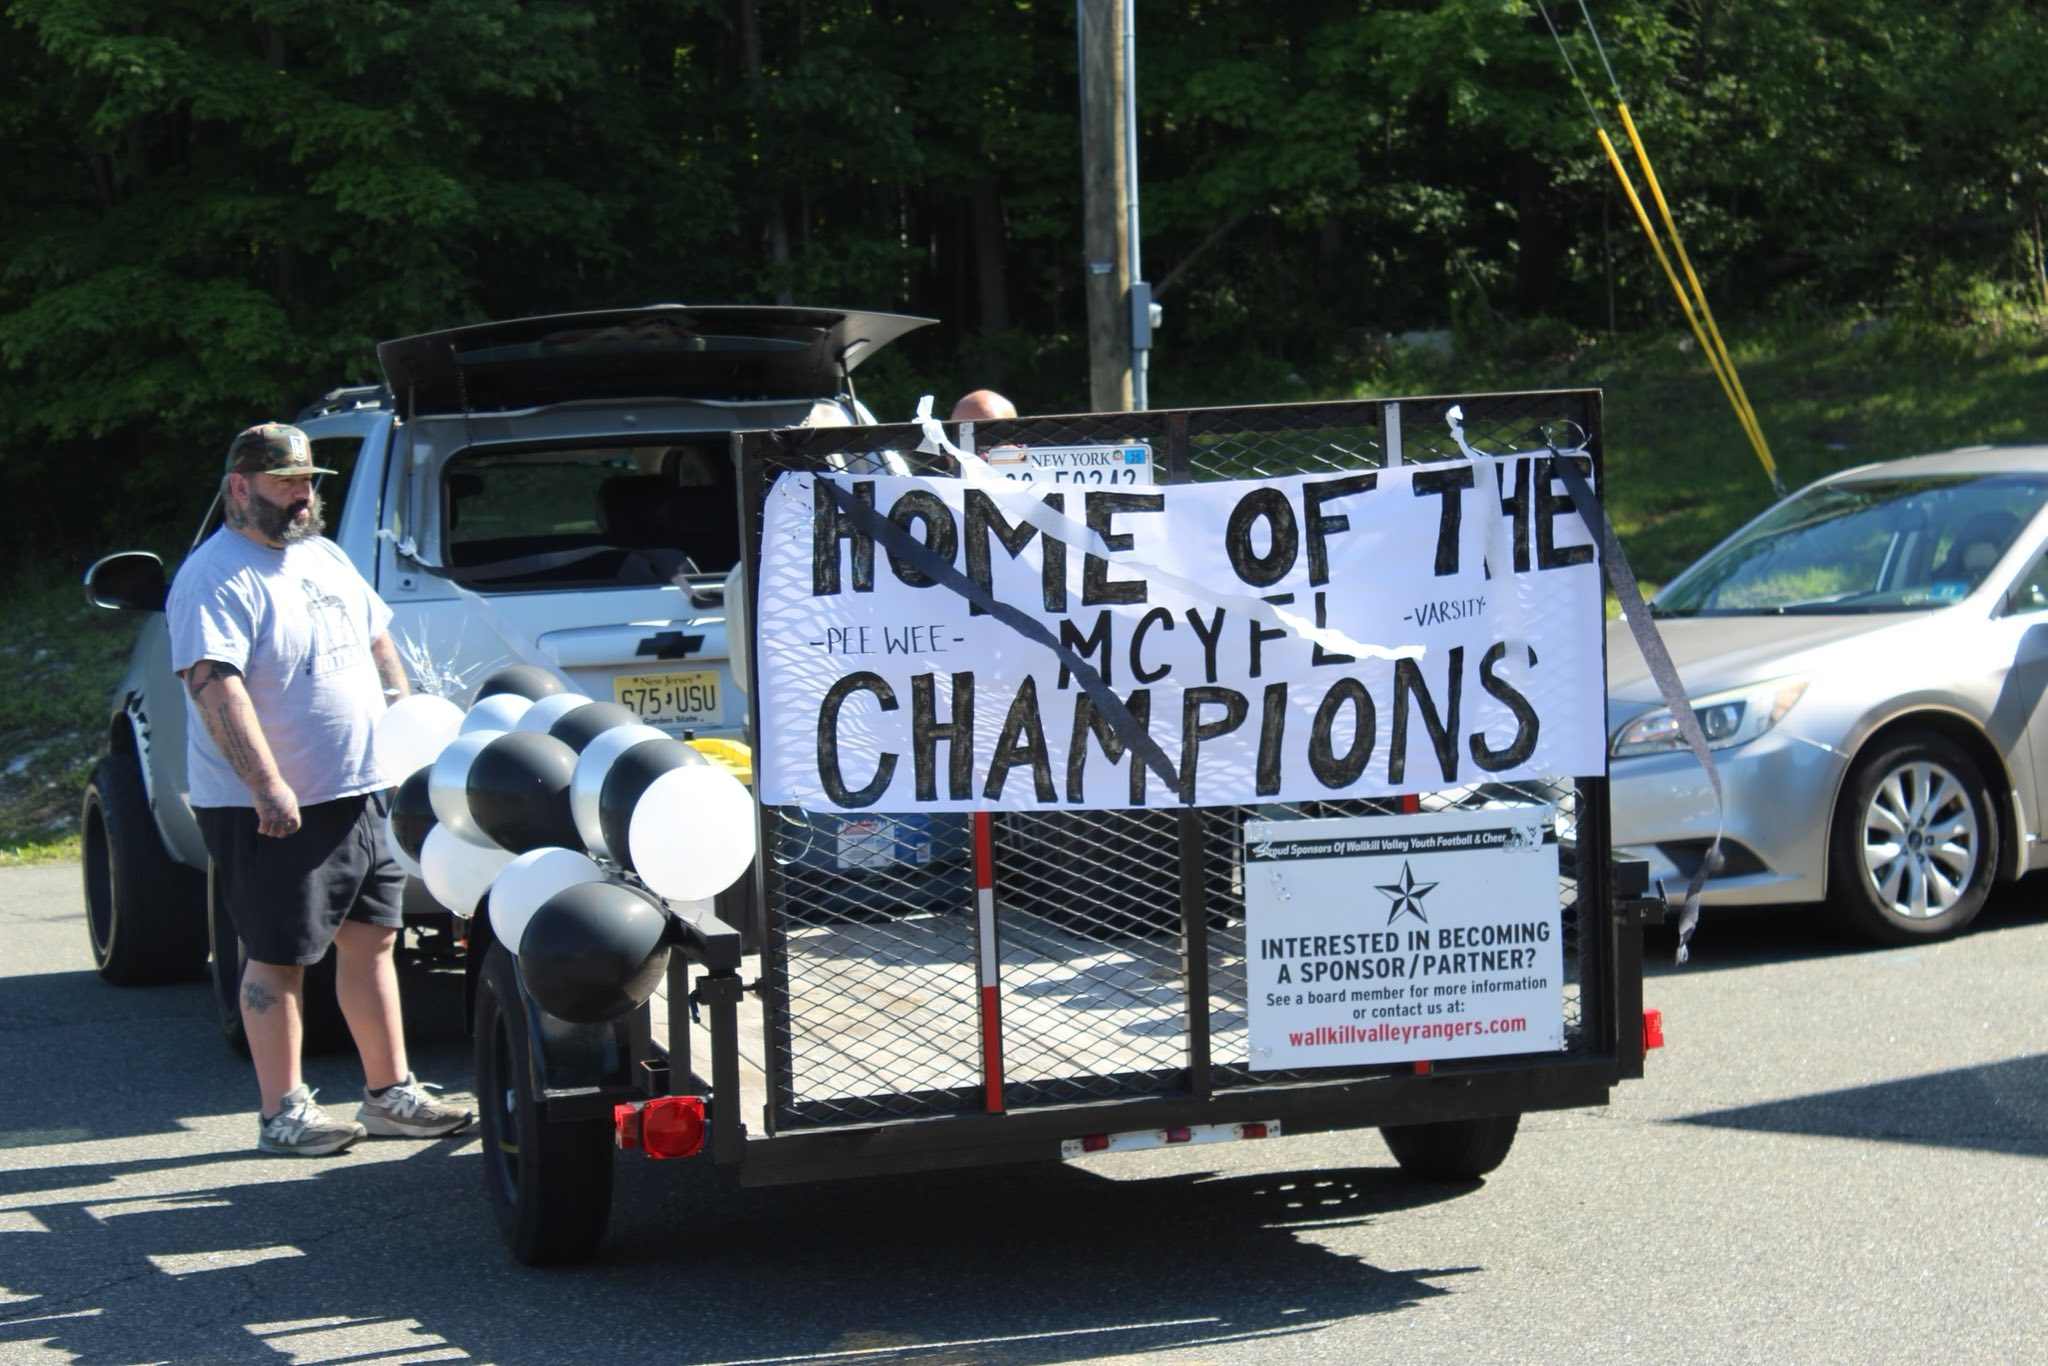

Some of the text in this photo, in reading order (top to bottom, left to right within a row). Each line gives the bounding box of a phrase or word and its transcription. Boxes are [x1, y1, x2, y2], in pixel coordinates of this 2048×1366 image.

[1032, 452, 1111, 467] NEW YORK
[812, 456, 1595, 617] HOME OF THE
[1057, 592, 1356, 690] MCYFL
[641, 675, 694, 687] New Jersey
[675, 715, 698, 723] State
[816, 640, 1540, 809] CHAMPIONS
[1290, 843, 1333, 857] Sponsors
[1334, 842, 1346, 855] Of
[1347, 840, 1380, 852] Wallkill
[1381, 838, 1409, 853] Valley
[1410, 836, 1436, 849] Youth
[1437, 834, 1473, 847] Football
[1474, 834, 1481, 844] &
[1482, 832, 1507, 844] Cheer
[1261, 921, 1550, 960] INTERESTED IN BECOMING
[1277, 947, 1536, 985] A SPONSOR/PARTNER?
[1266, 976, 1547, 1007] See a board member for more information
[1353, 1000, 1465, 1019] or contact us at:
[1289, 1016, 1527, 1047] wallkillvalleyrangers.com
